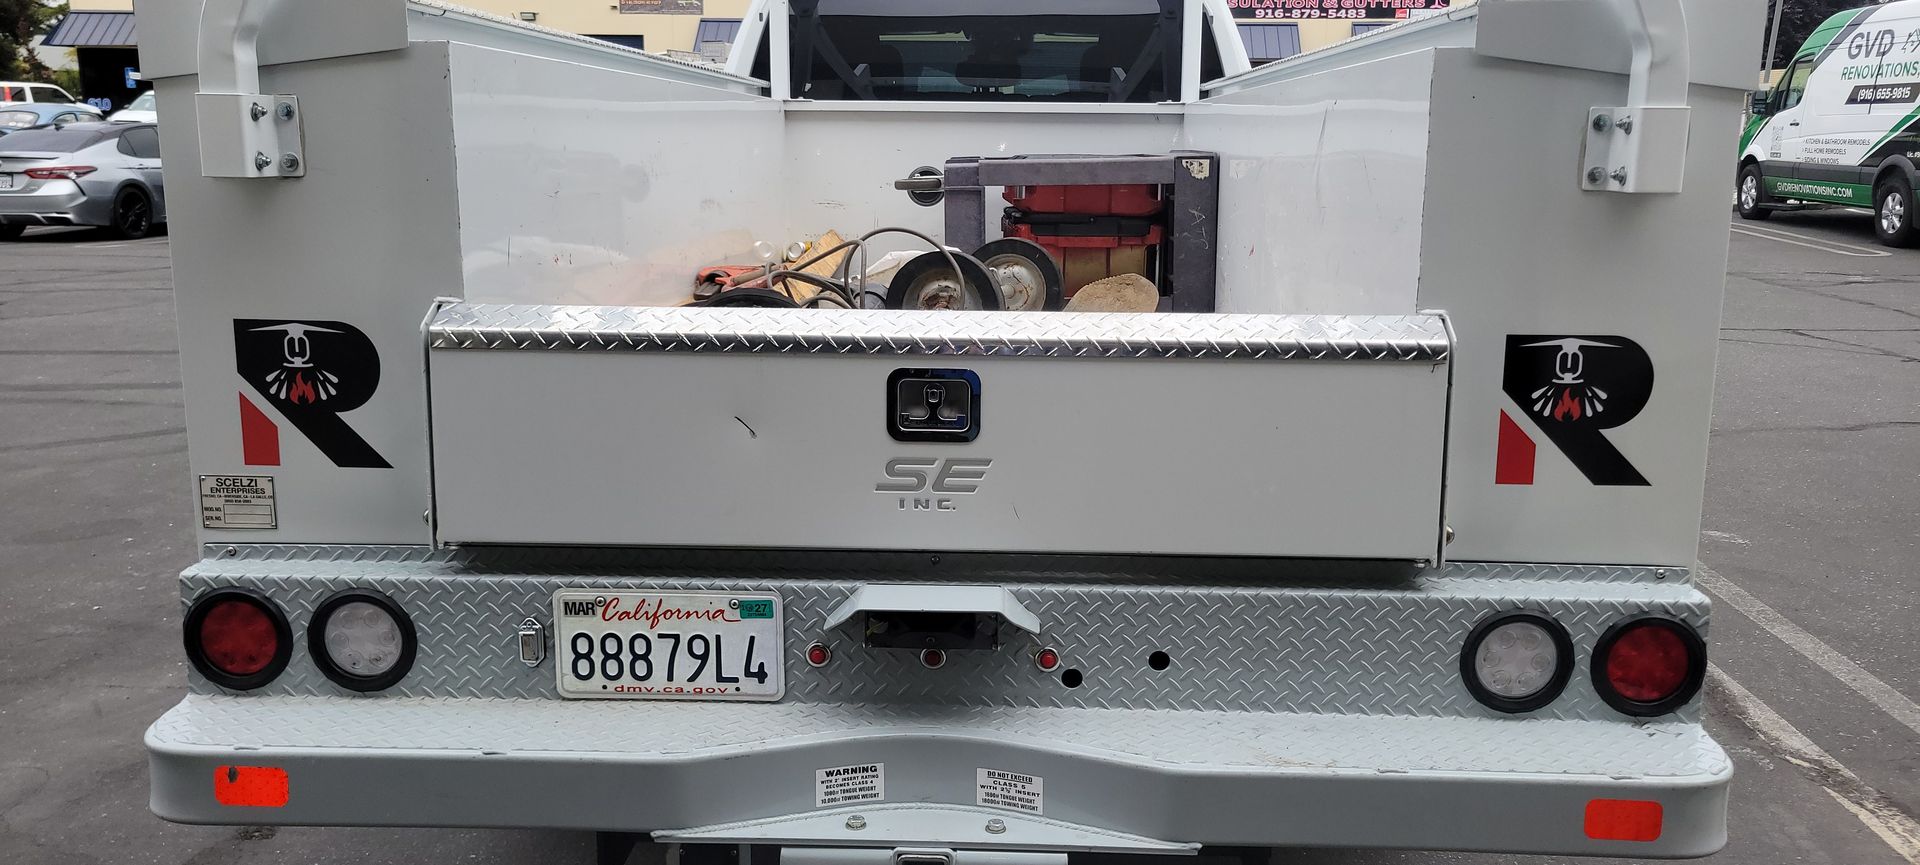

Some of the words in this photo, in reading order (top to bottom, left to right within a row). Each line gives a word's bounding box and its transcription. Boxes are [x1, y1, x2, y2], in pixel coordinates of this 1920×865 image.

[1255, 9, 1366, 18] 916-879-5483
[1848, 29, 1895, 60] GVD
[1876, 87, 1911, 100] 655-9815
[1777, 182, 1853, 198] GVDRENOVATIONSINC.COM
[874, 457, 993, 494] SE
[216, 478, 258, 487] SCELZI
[898, 498, 956, 511] INC.
[564, 601, 596, 616] MAR
[602, 597, 741, 630] California
[755, 604, 767, 612] 27
[571, 632, 768, 684] 88879L4
[614, 684, 729, 696] dmv.ca.gov
[825, 765, 877, 777] WARNING
[993, 780, 1018, 788] CLASS
[1011, 774, 1033, 783] EXCEED
[842, 794, 860, 802] TOWING
[1015, 790, 1040, 798] INSERT
[1001, 800, 1019, 808] TOWING
[1017, 797, 1035, 805] WEIGHT
